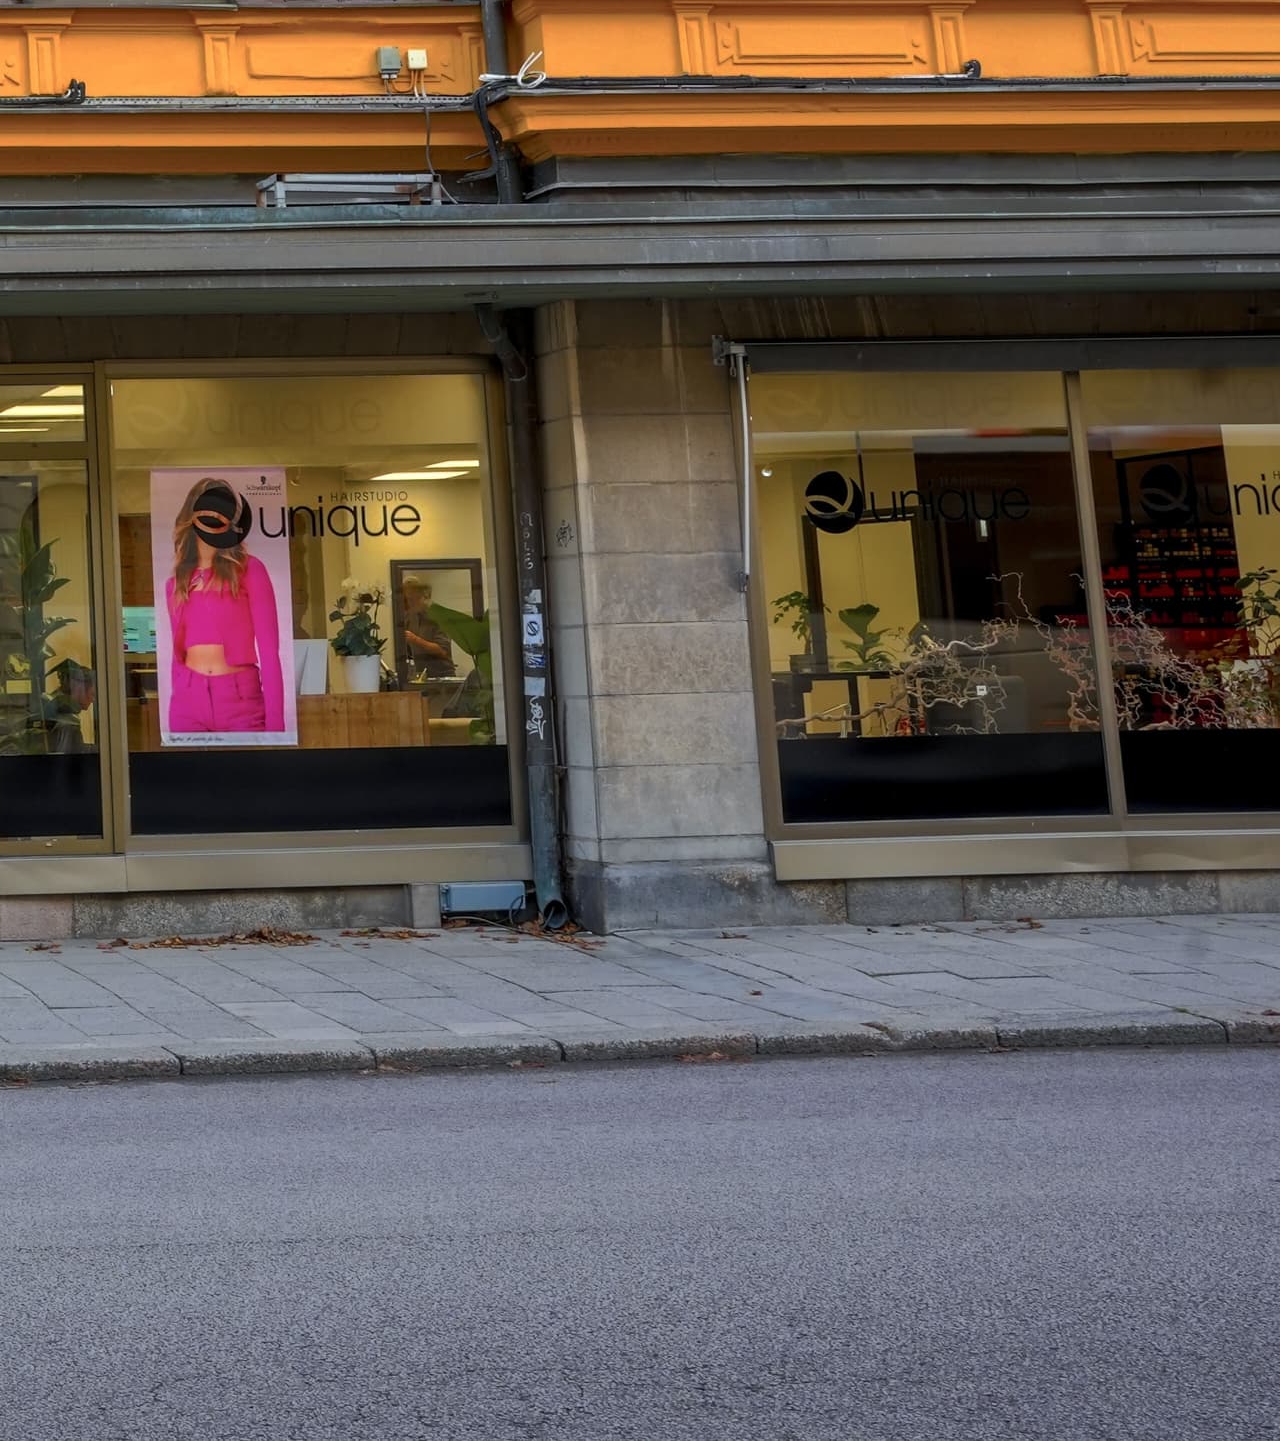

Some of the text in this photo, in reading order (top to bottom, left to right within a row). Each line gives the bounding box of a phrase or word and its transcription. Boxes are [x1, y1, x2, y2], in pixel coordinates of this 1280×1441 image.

[330, 490, 408, 502] HAIRSTUDIO
[870, 480, 1030, 526] unique
[259, 496, 421, 547] unique
